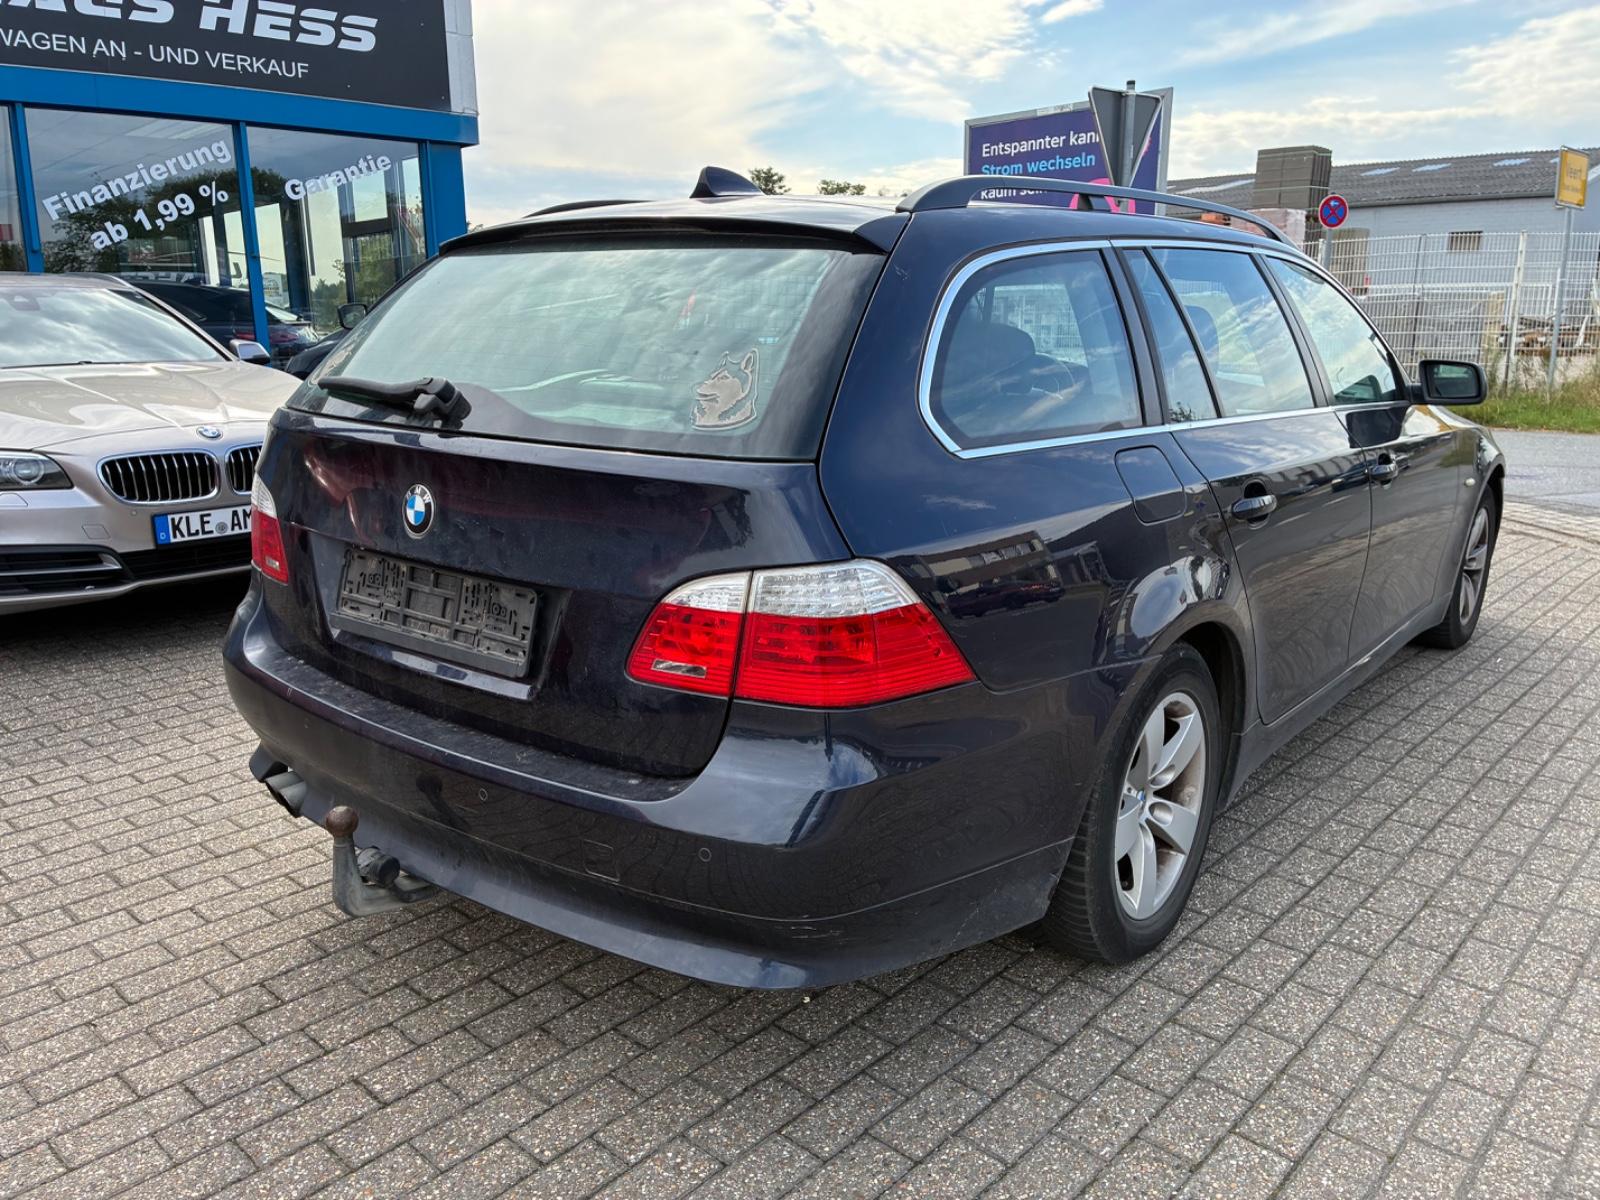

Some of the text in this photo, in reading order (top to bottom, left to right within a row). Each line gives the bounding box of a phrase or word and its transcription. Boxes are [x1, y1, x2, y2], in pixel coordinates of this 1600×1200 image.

[199, 0, 379, 52] HESS
[93, 38, 126, 58] AN
[149, 44, 199, 66] UND
[205, 50, 309, 79] VERKAUF
[981, 135, 1066, 158] Entspannter
[981, 152, 1096, 176] Strom wechseln
[42, 140, 232, 221] Finanzierung
[284, 154, 392, 201] Garantie
[90, 180, 229, 250] ab 1,99 %
[170, 512, 215, 540] KLE
